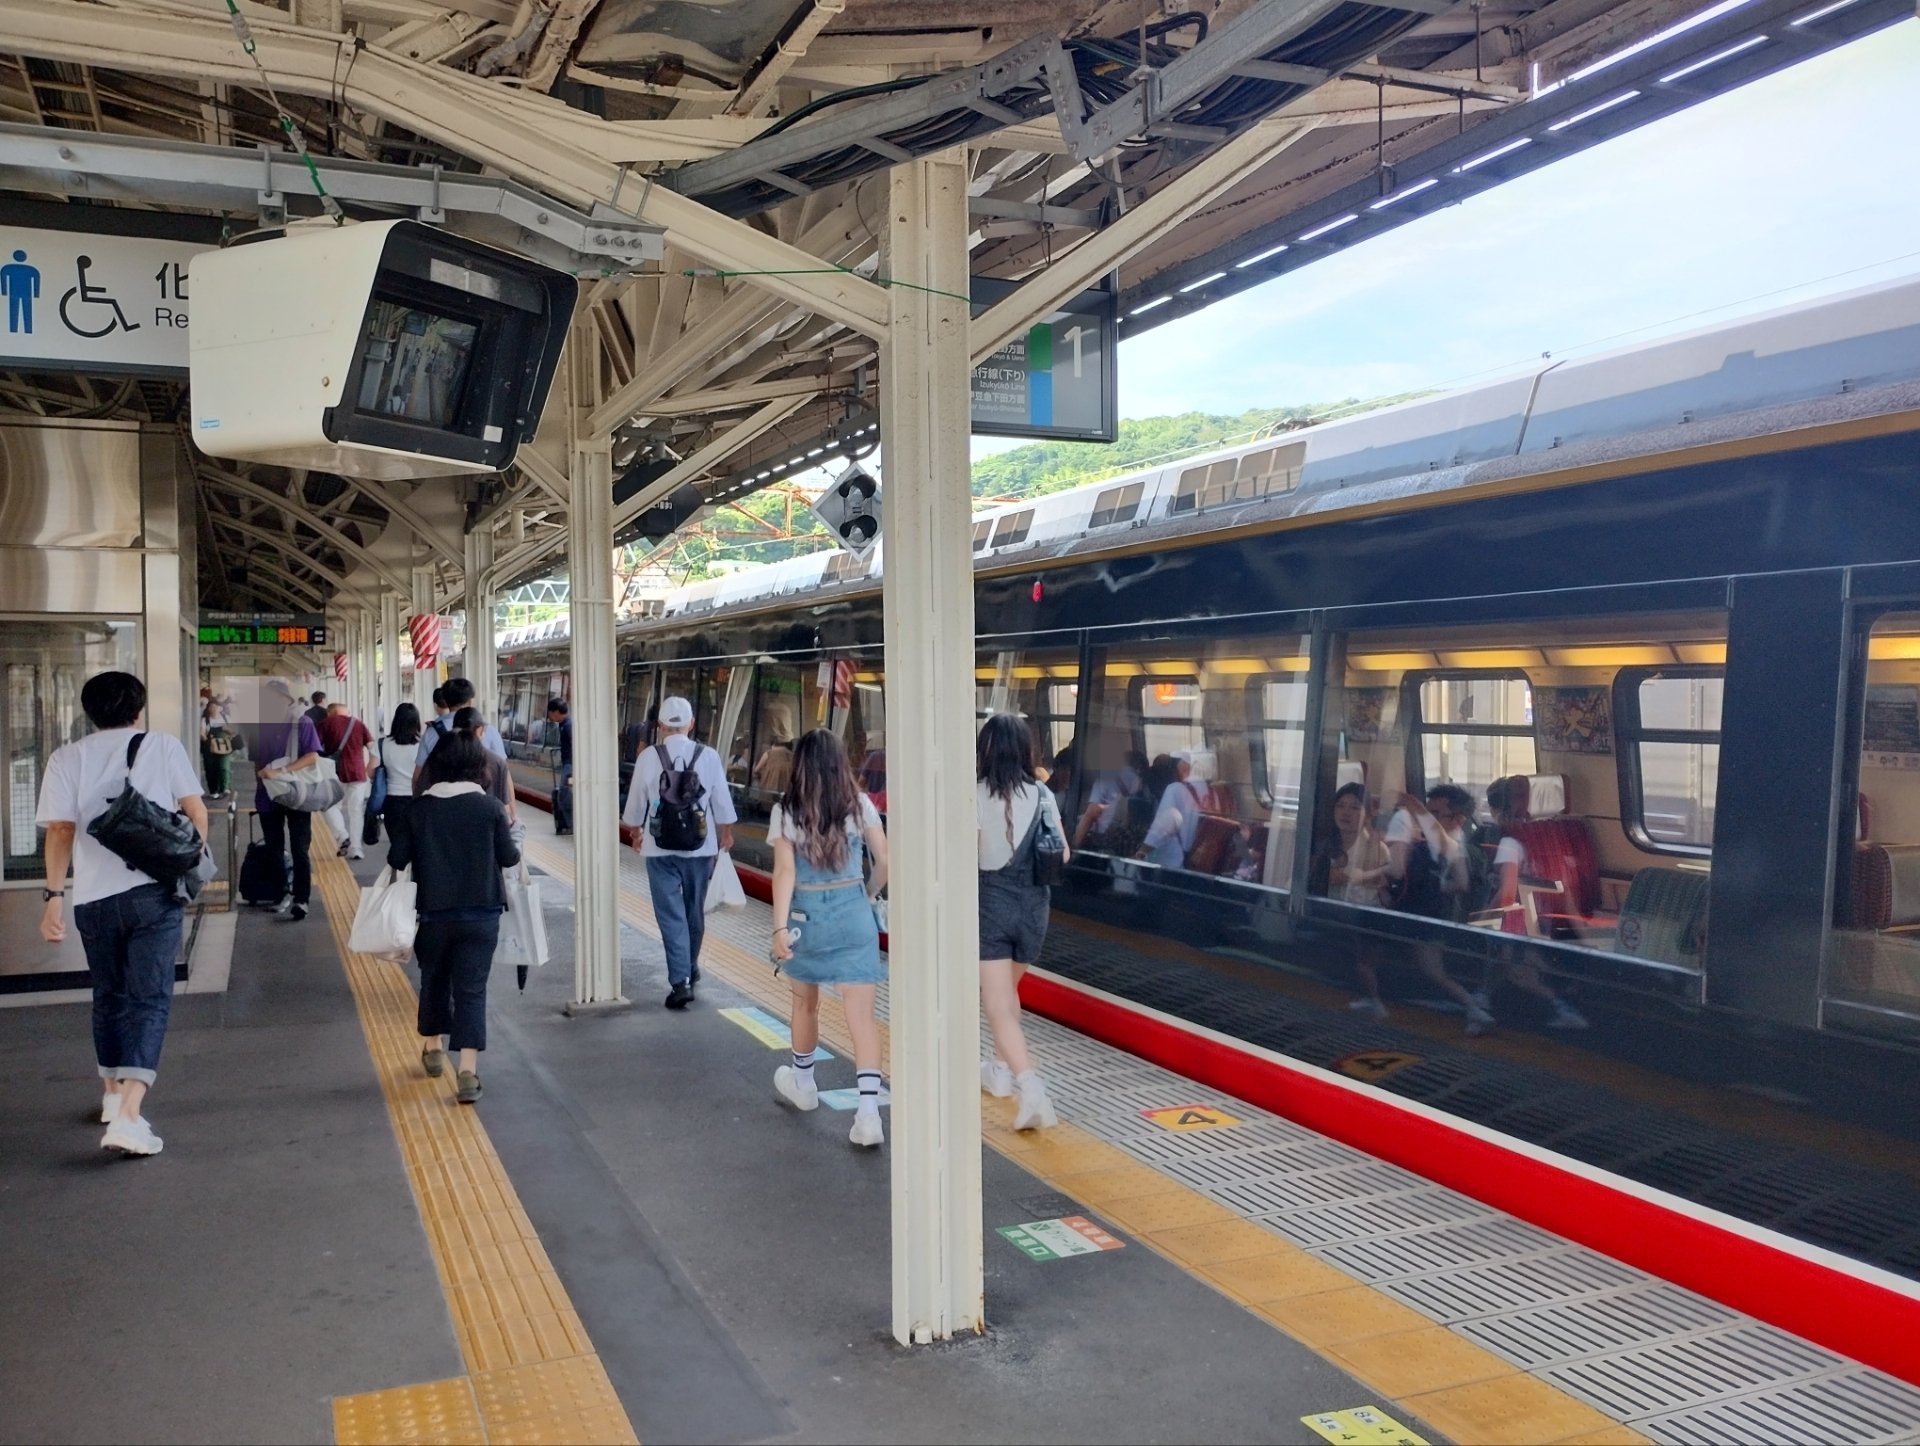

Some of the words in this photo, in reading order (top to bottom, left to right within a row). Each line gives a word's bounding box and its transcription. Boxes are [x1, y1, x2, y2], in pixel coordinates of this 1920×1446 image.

[155, 307, 189, 329] Re
[1064, 326, 1082, 377] 1
[1177, 1110, 1217, 1125] 4
